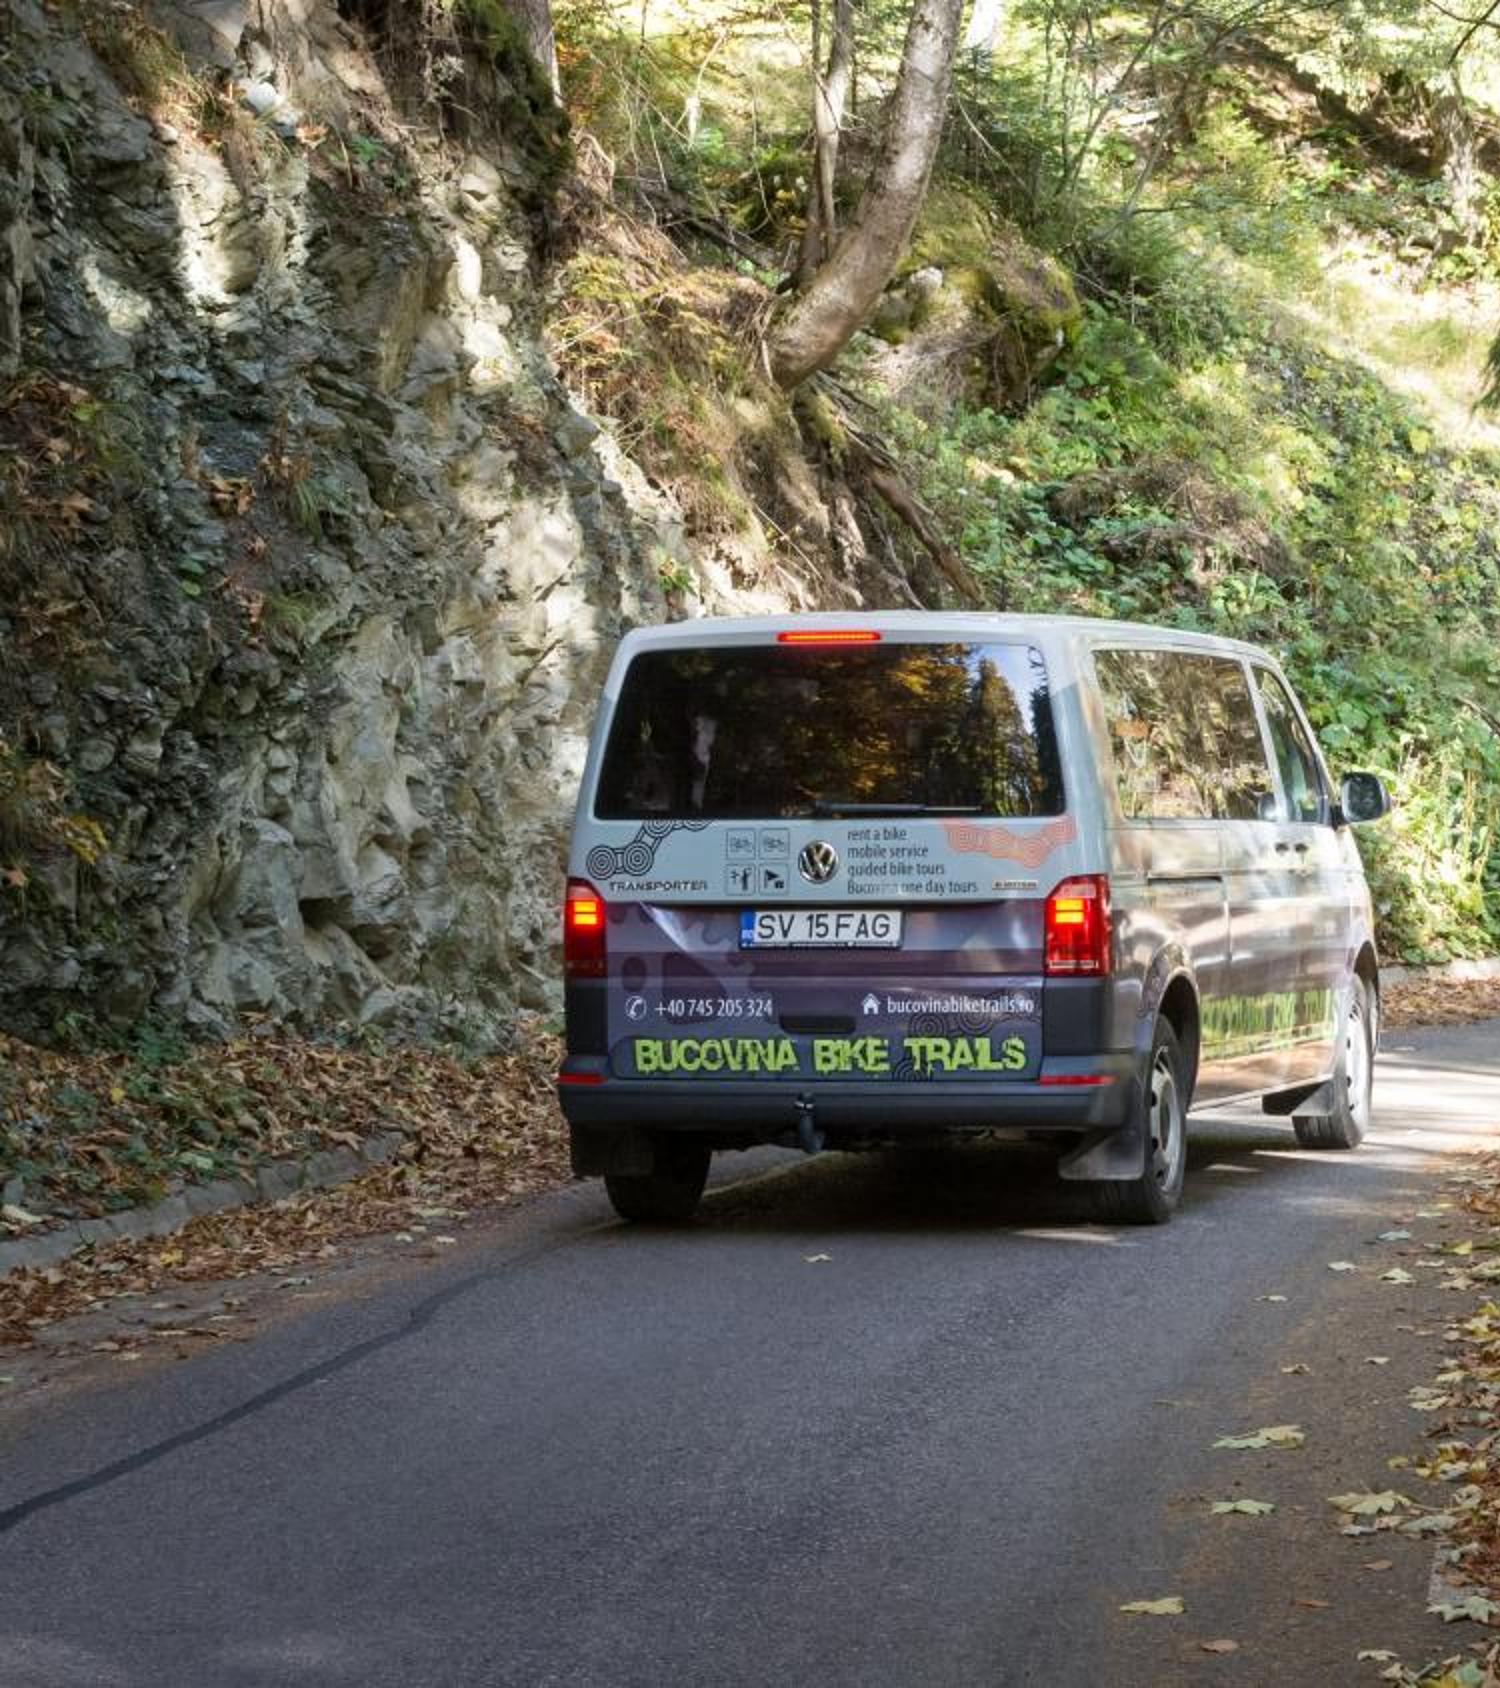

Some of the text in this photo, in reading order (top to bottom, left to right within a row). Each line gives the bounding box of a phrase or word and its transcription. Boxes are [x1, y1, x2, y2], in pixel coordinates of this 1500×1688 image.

[847, 827, 907, 841] rent a bike
[847, 844, 928, 858] mobile service
[847, 862, 945, 876] guided bike tours
[609, 880, 708, 891] TRANSPORTER
[901, 883, 923, 893] one
[925, 880, 945, 896] day
[948, 881, 977, 893] tours
[758, 913, 891, 939] SV 15 FAG
[655, 999, 773, 1017] +40 745 205 324
[887, 996, 1034, 1013] bucovinabiketrails.ro
[635, 1037, 1026, 1073] BUCOVINA BIKE TRAILS
